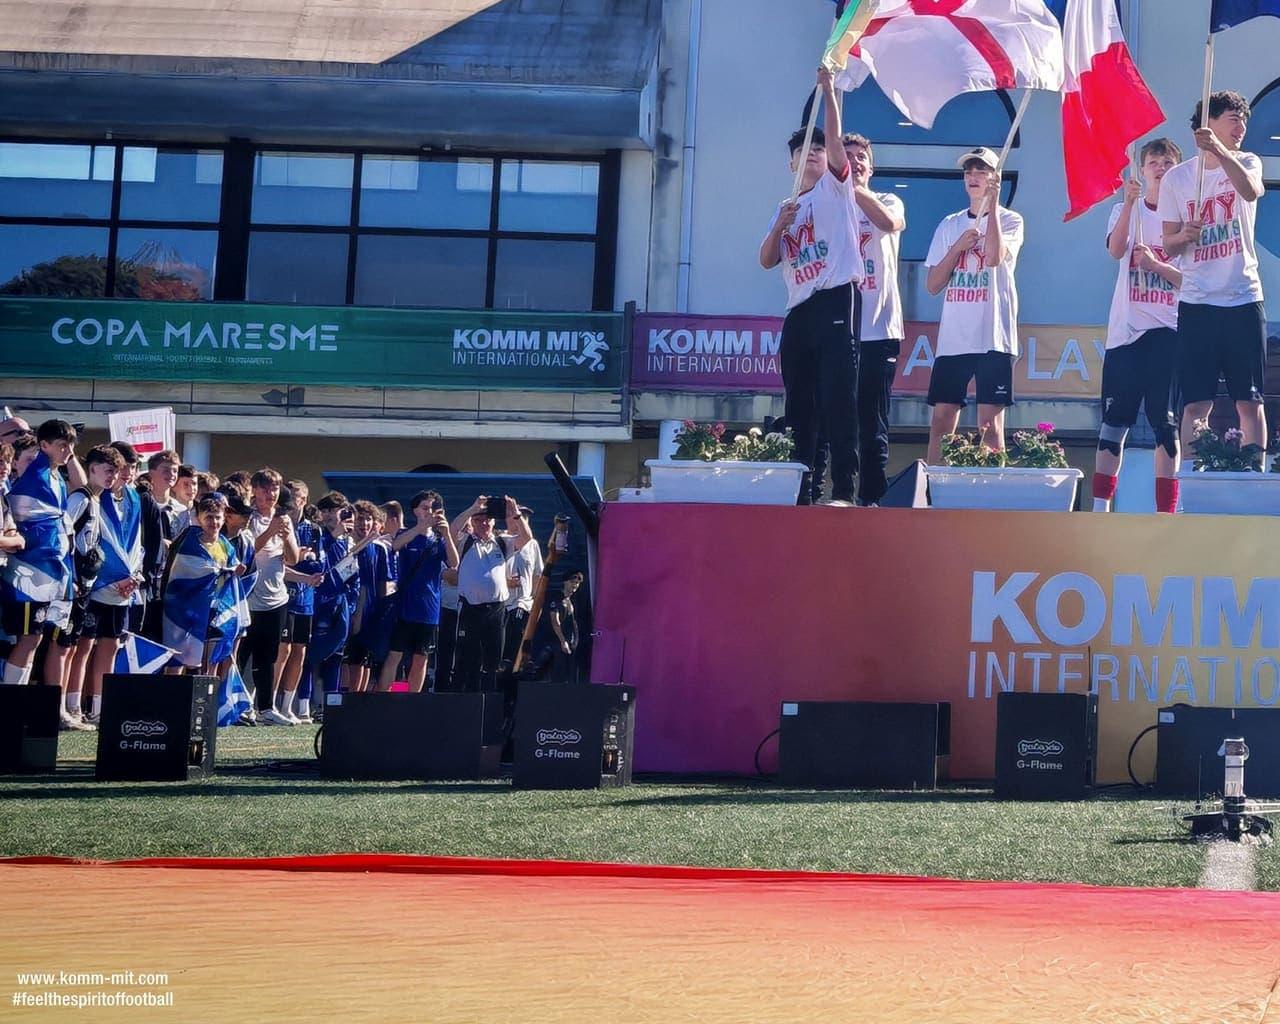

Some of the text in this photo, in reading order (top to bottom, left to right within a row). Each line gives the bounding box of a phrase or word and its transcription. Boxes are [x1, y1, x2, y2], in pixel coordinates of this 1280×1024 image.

[1197, 224, 1229, 246] EAM
[1194, 238, 1242, 263] EUROPE
[51, 317, 339, 351] COPA MARESME
[453, 329, 540, 351] KOMM
[647, 329, 752, 355] KOMM
[453, 351, 570, 367] INTERNATIONAL
[647, 355, 782, 375] INTERNATIONA
[120, 740, 166, 750] G-Flame
[535, 749, 580, 759] G-Flame
[1016, 759, 1063, 770] G-Flame
